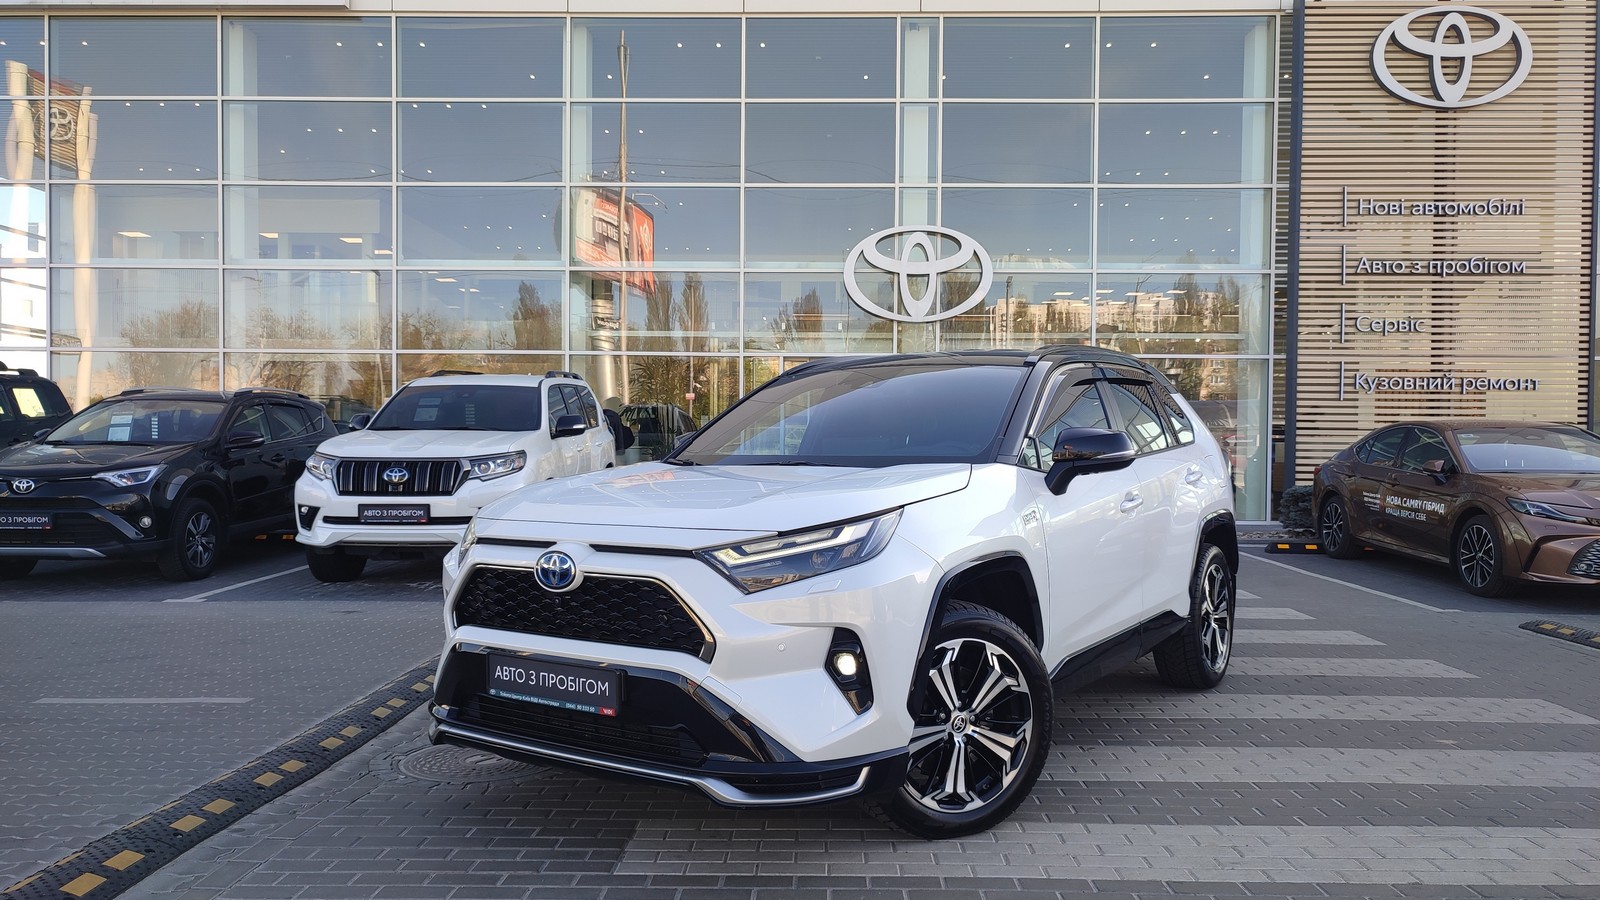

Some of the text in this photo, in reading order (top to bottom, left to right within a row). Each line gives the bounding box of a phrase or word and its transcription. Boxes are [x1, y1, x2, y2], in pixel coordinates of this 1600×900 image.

[1358, 197, 1526, 216] Нові автомобілі
[1356, 256, 1527, 278] Авто з пробігом
[1355, 315, 1426, 337] Сервіс
[1354, 373, 1542, 395] Кузовний ремонт
[1386, 495, 1401, 506] НОВА
[1402, 497, 1422, 509] CAMRY
[1422, 500, 1445, 515] ГІБРИД
[1415, 512, 1427, 522] СЕБЕ
[494, 665, 609, 697] АВТО З ПРОБІГОМ
